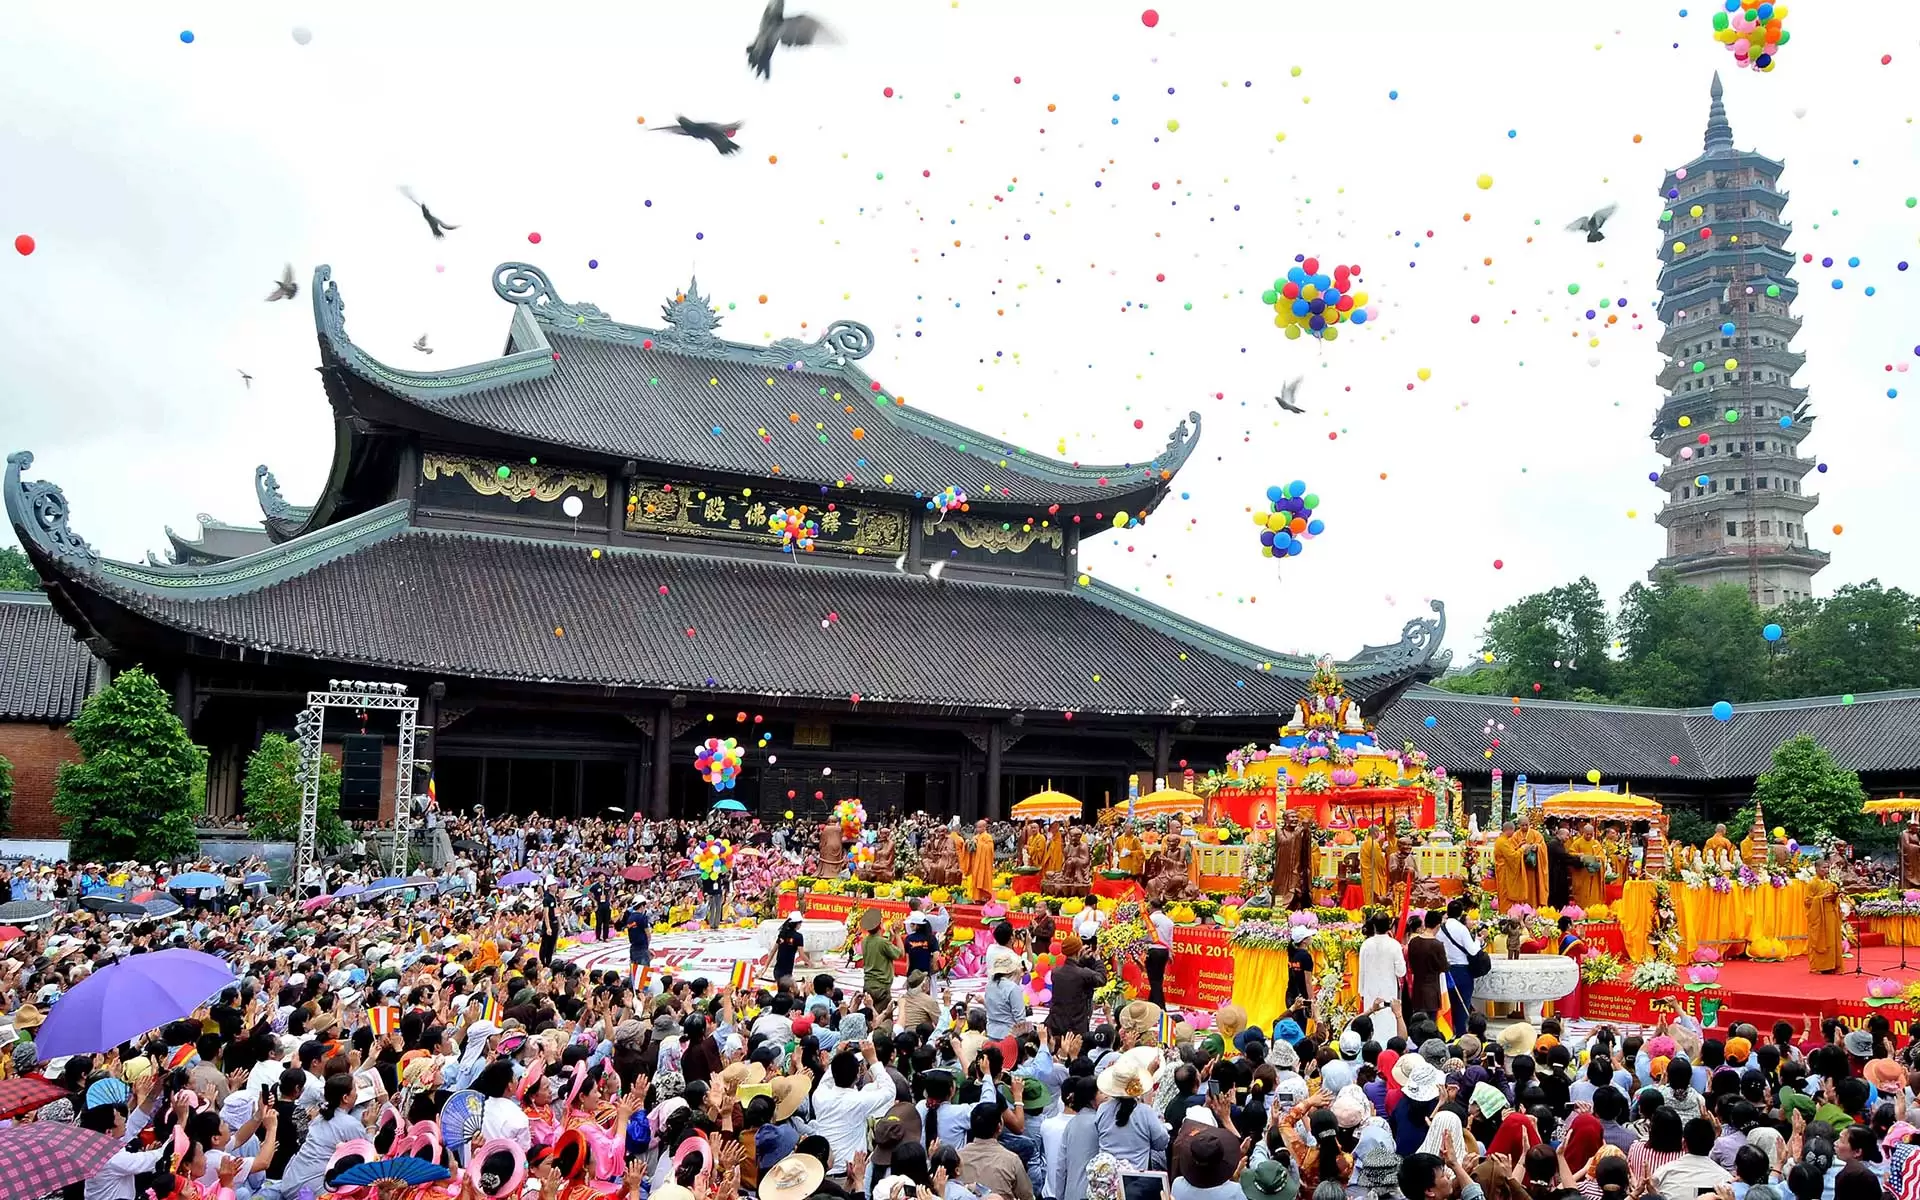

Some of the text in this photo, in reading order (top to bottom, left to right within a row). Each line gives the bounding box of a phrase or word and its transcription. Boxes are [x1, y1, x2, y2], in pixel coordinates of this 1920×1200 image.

[813, 902, 831, 912] VESAK
[1172, 942, 1202, 955] ESAK
[1199, 970, 1229, 980] Sustainable
